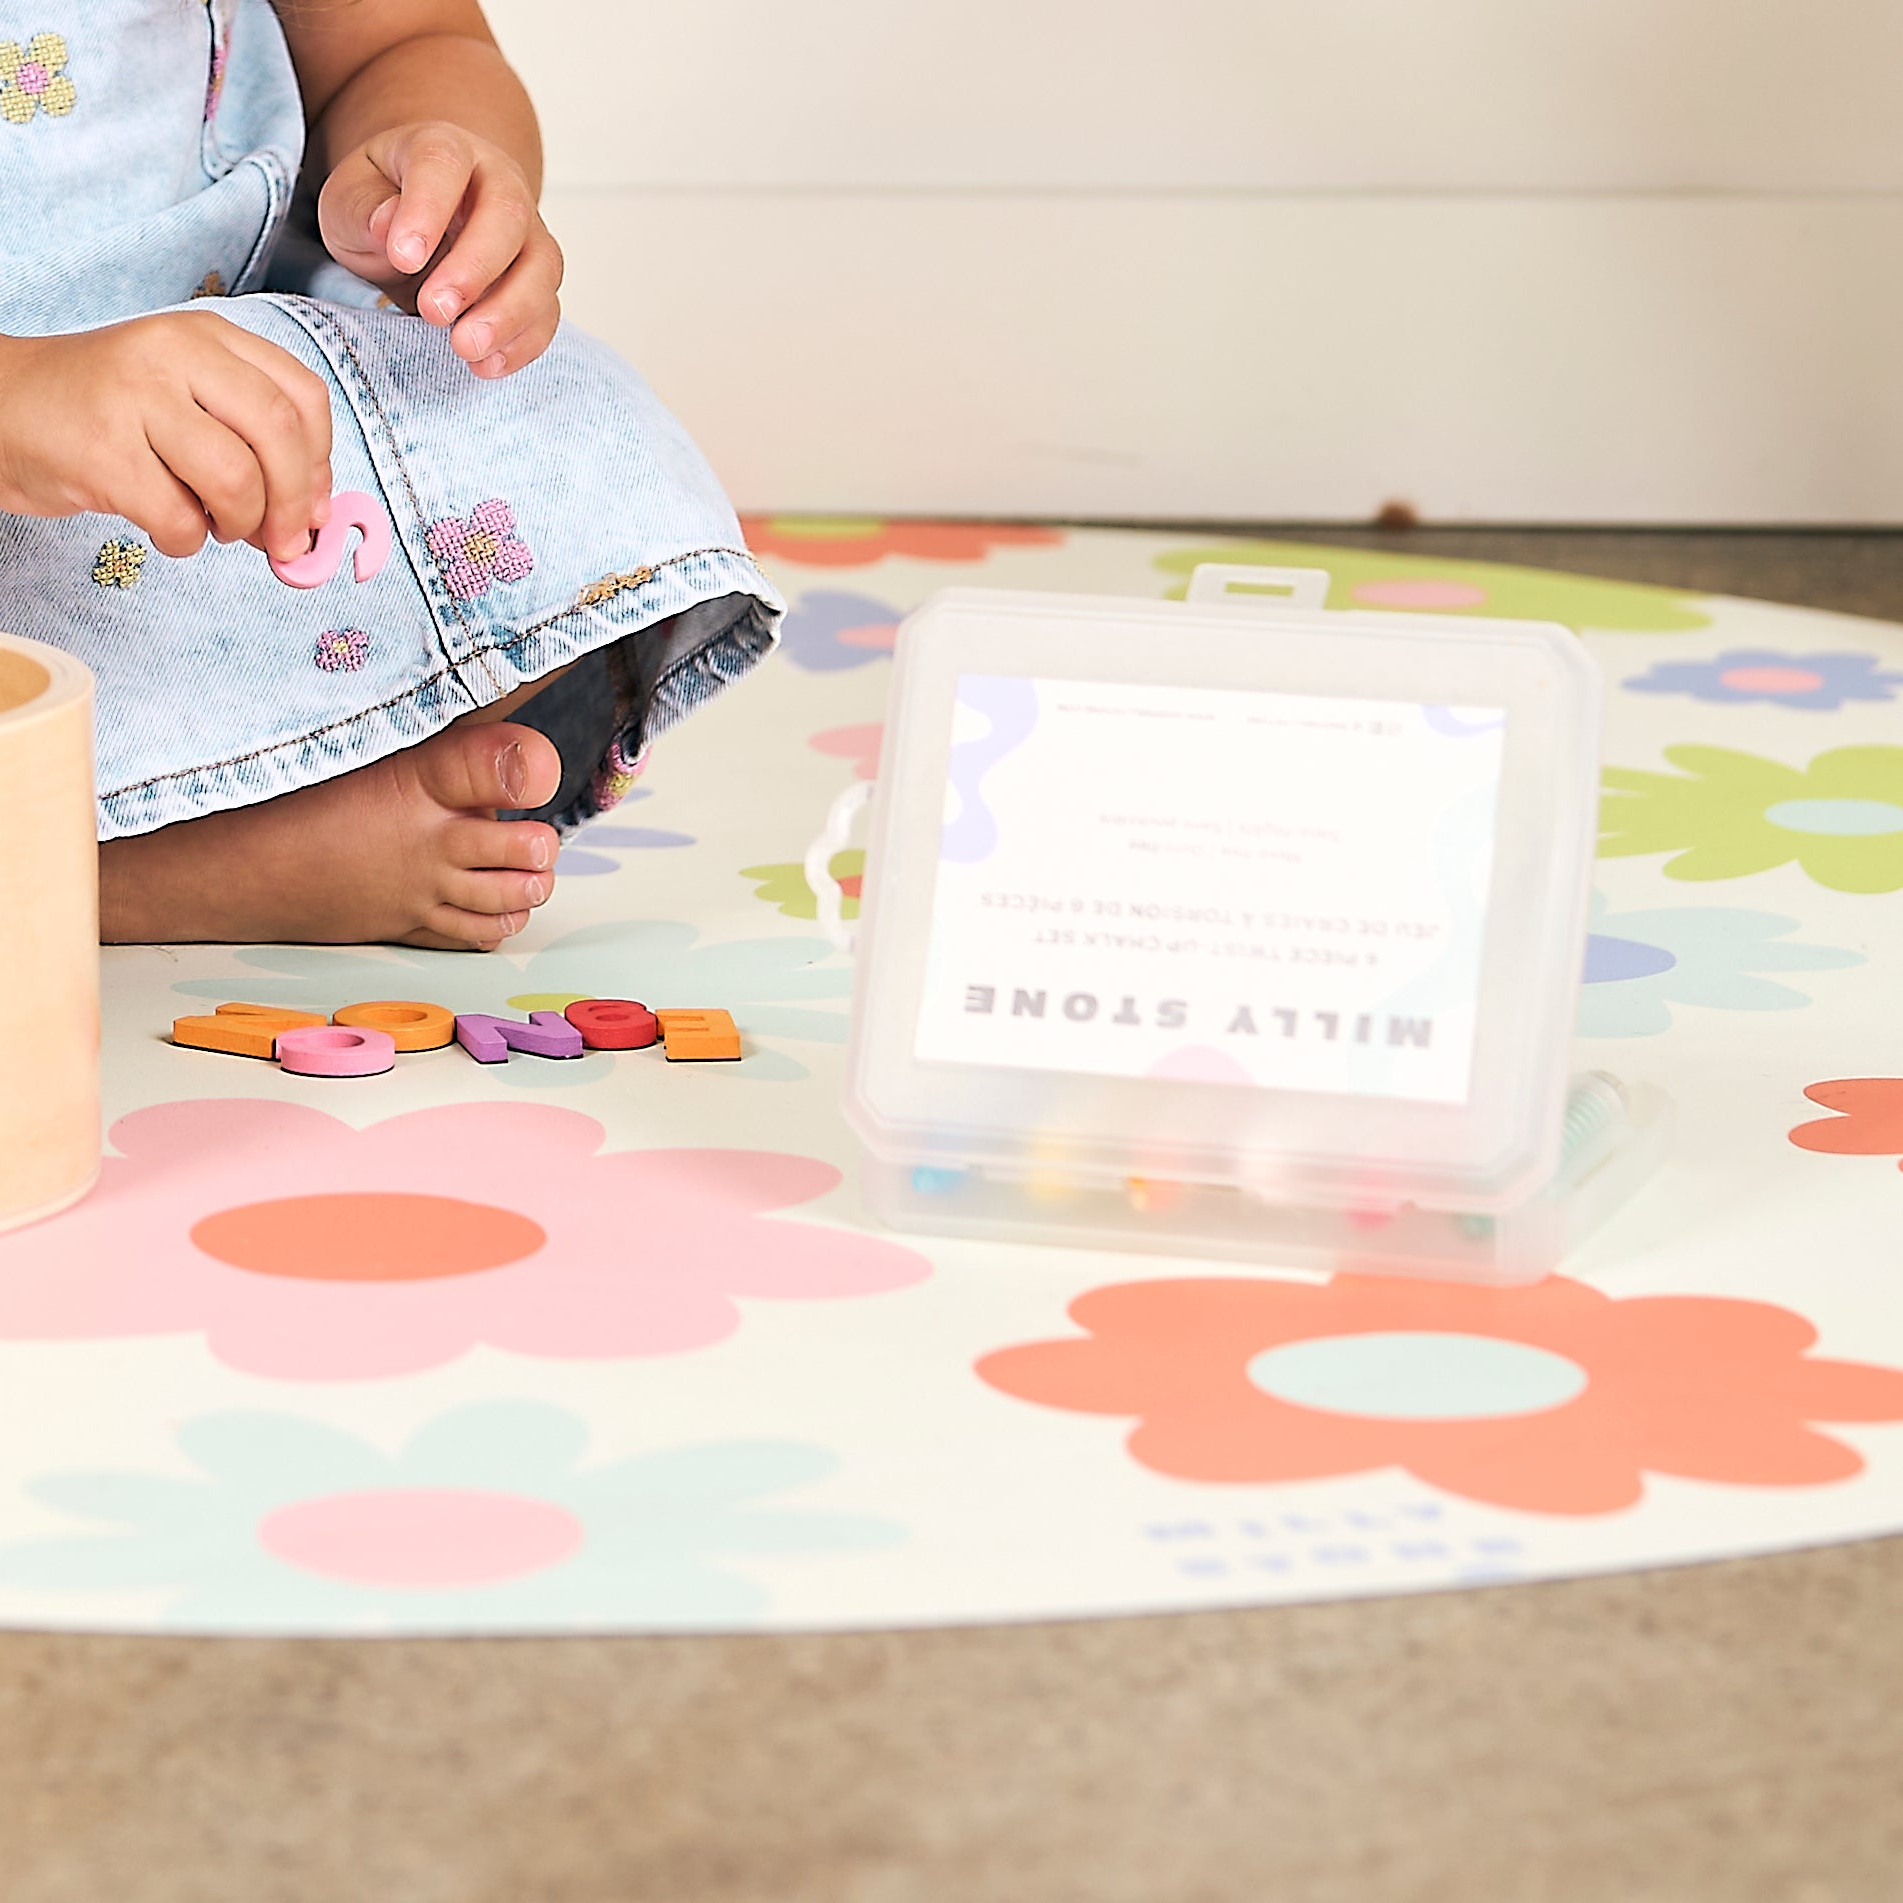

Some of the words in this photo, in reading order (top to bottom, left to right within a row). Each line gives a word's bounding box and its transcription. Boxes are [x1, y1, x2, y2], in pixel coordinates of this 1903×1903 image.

[1092, 900, 1122, 918] DE
[1032, 928, 1075, 945] SET
[963, 985, 1188, 1029] STONE
[1224, 1004, 1433, 1049] MILLY
